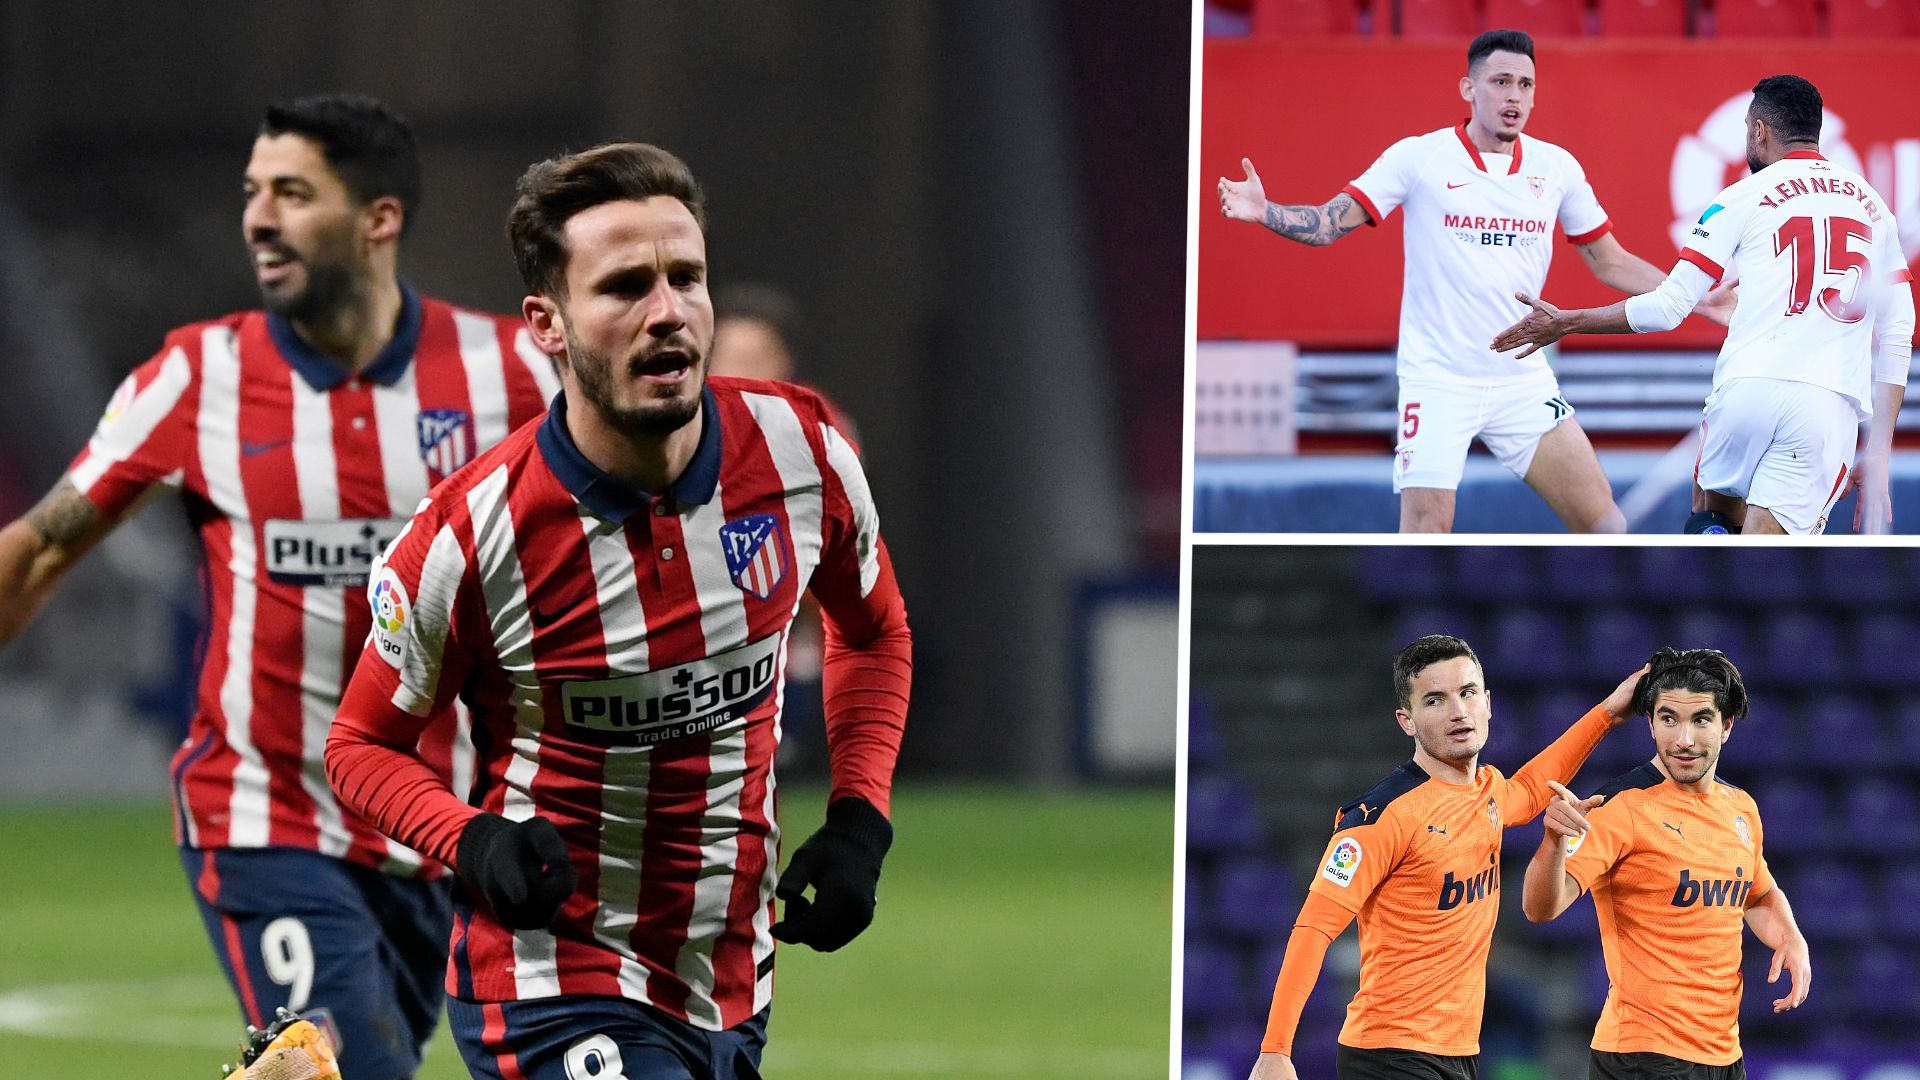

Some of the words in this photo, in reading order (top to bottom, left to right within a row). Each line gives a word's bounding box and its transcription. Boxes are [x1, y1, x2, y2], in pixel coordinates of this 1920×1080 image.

[1444, 213, 1547, 234] MARATHON
[1480, 232, 1517, 247] BET
[1773, 215, 1873, 324] 15
[1402, 402, 1421, 440] 5
[569, 651, 774, 728] Plus500
[635, 727, 681, 744] Trade
[685, 711, 731, 735] Online
[260, 916, 315, 1011] 9
